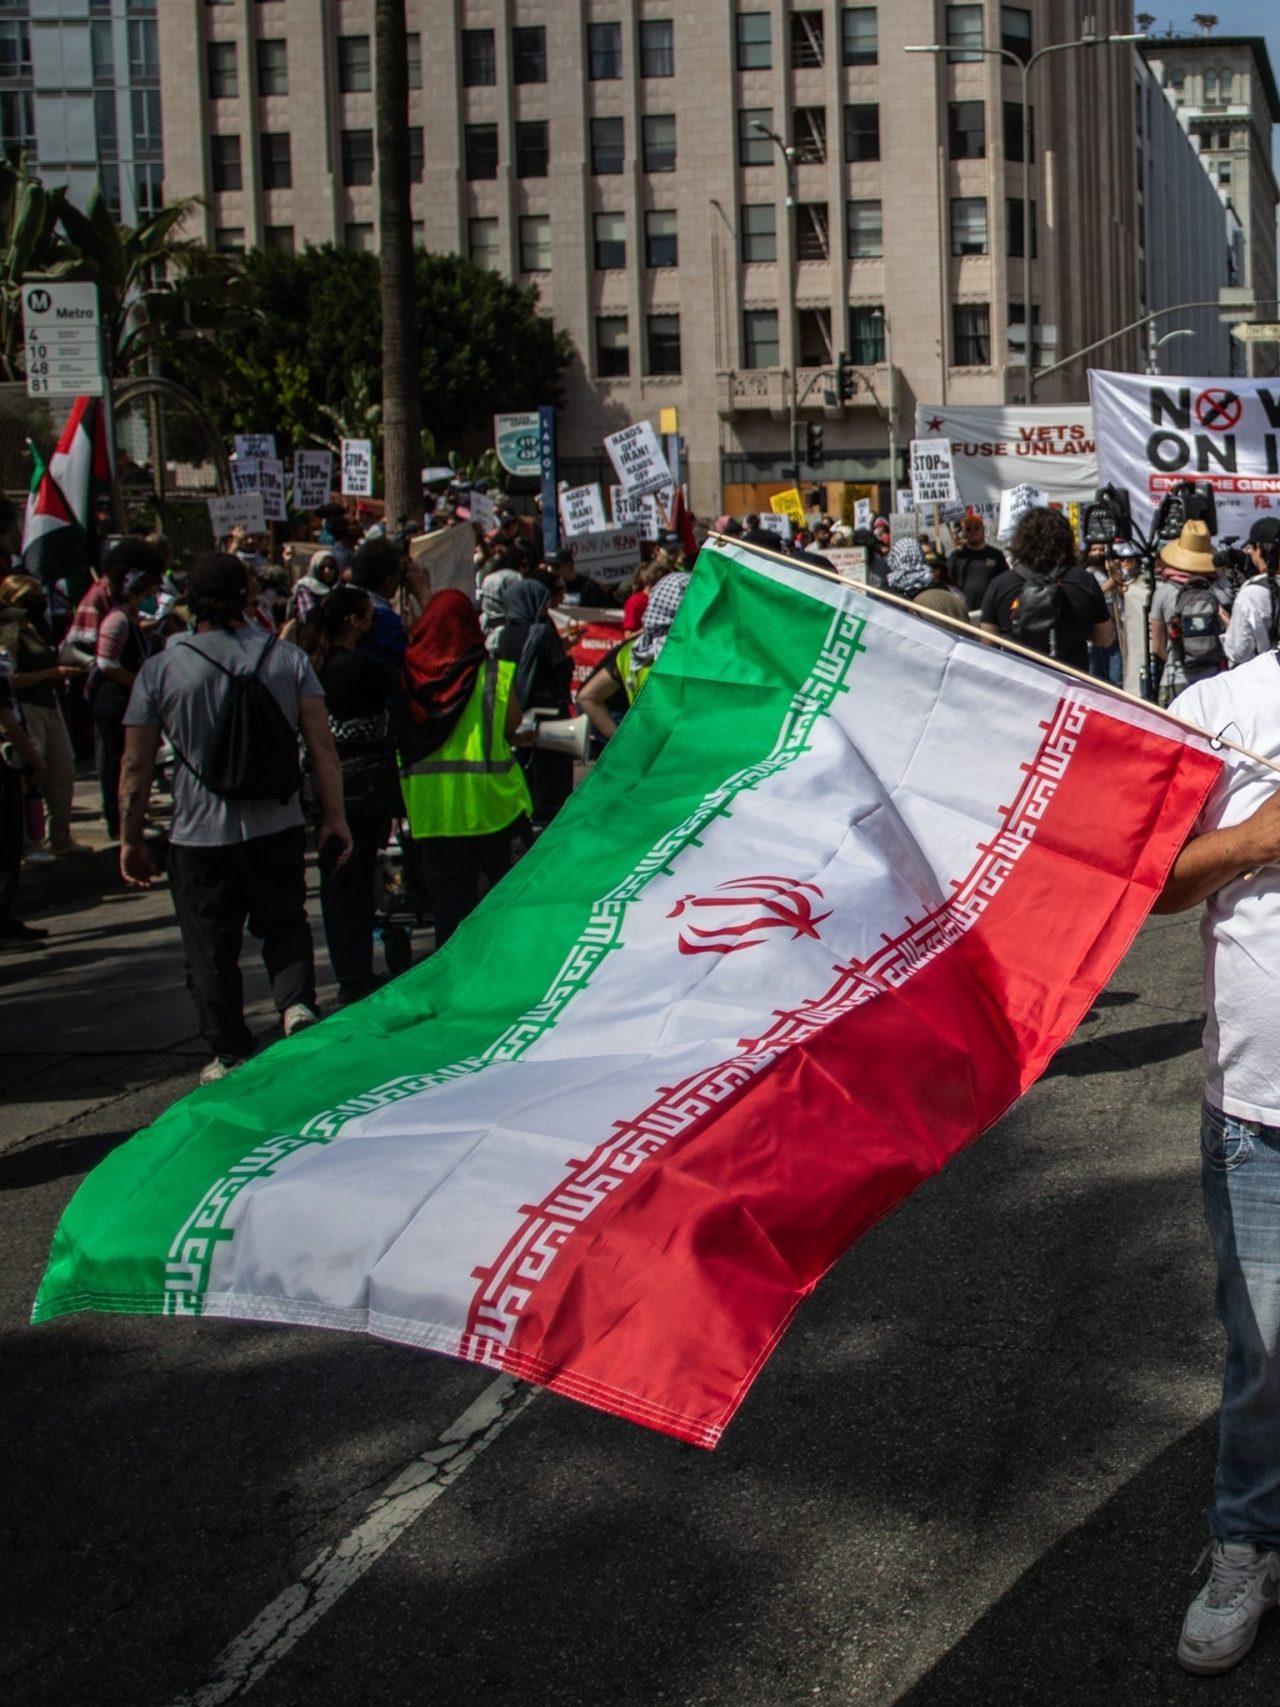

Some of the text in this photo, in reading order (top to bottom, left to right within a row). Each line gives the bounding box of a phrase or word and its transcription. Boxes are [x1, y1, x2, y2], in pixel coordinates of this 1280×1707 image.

[56, 308, 94, 319] Metro
[28, 328, 38, 340] 4
[1247, 326, 1266, 335] ONE
[30, 346, 47, 358] 10
[31, 361, 49, 375] 48
[32, 379, 48, 391] 81
[611, 425, 643, 446] HANDS
[1018, 424, 1086, 442] VETS
[543, 419, 551, 480] LADOT
[621, 438, 637, 453] OFF
[951, 441, 1008, 457] FUSE
[1015, 440, 1096, 456] UNLAW
[1146, 430, 1238, 473] ON
[620, 444, 650, 465] IRAN!
[626, 458, 654, 475] HANDS
[913, 453, 940, 471] STOP
[634, 469, 649, 482] OFF
[919, 481, 935, 489] War
[566, 488, 591, 501] HANDS
[918, 489, 950, 500] IRAN!
[571, 500, 584, 510] OFF
[615, 498, 642, 513] STOP
[569, 505, 593, 520] IRAN!
